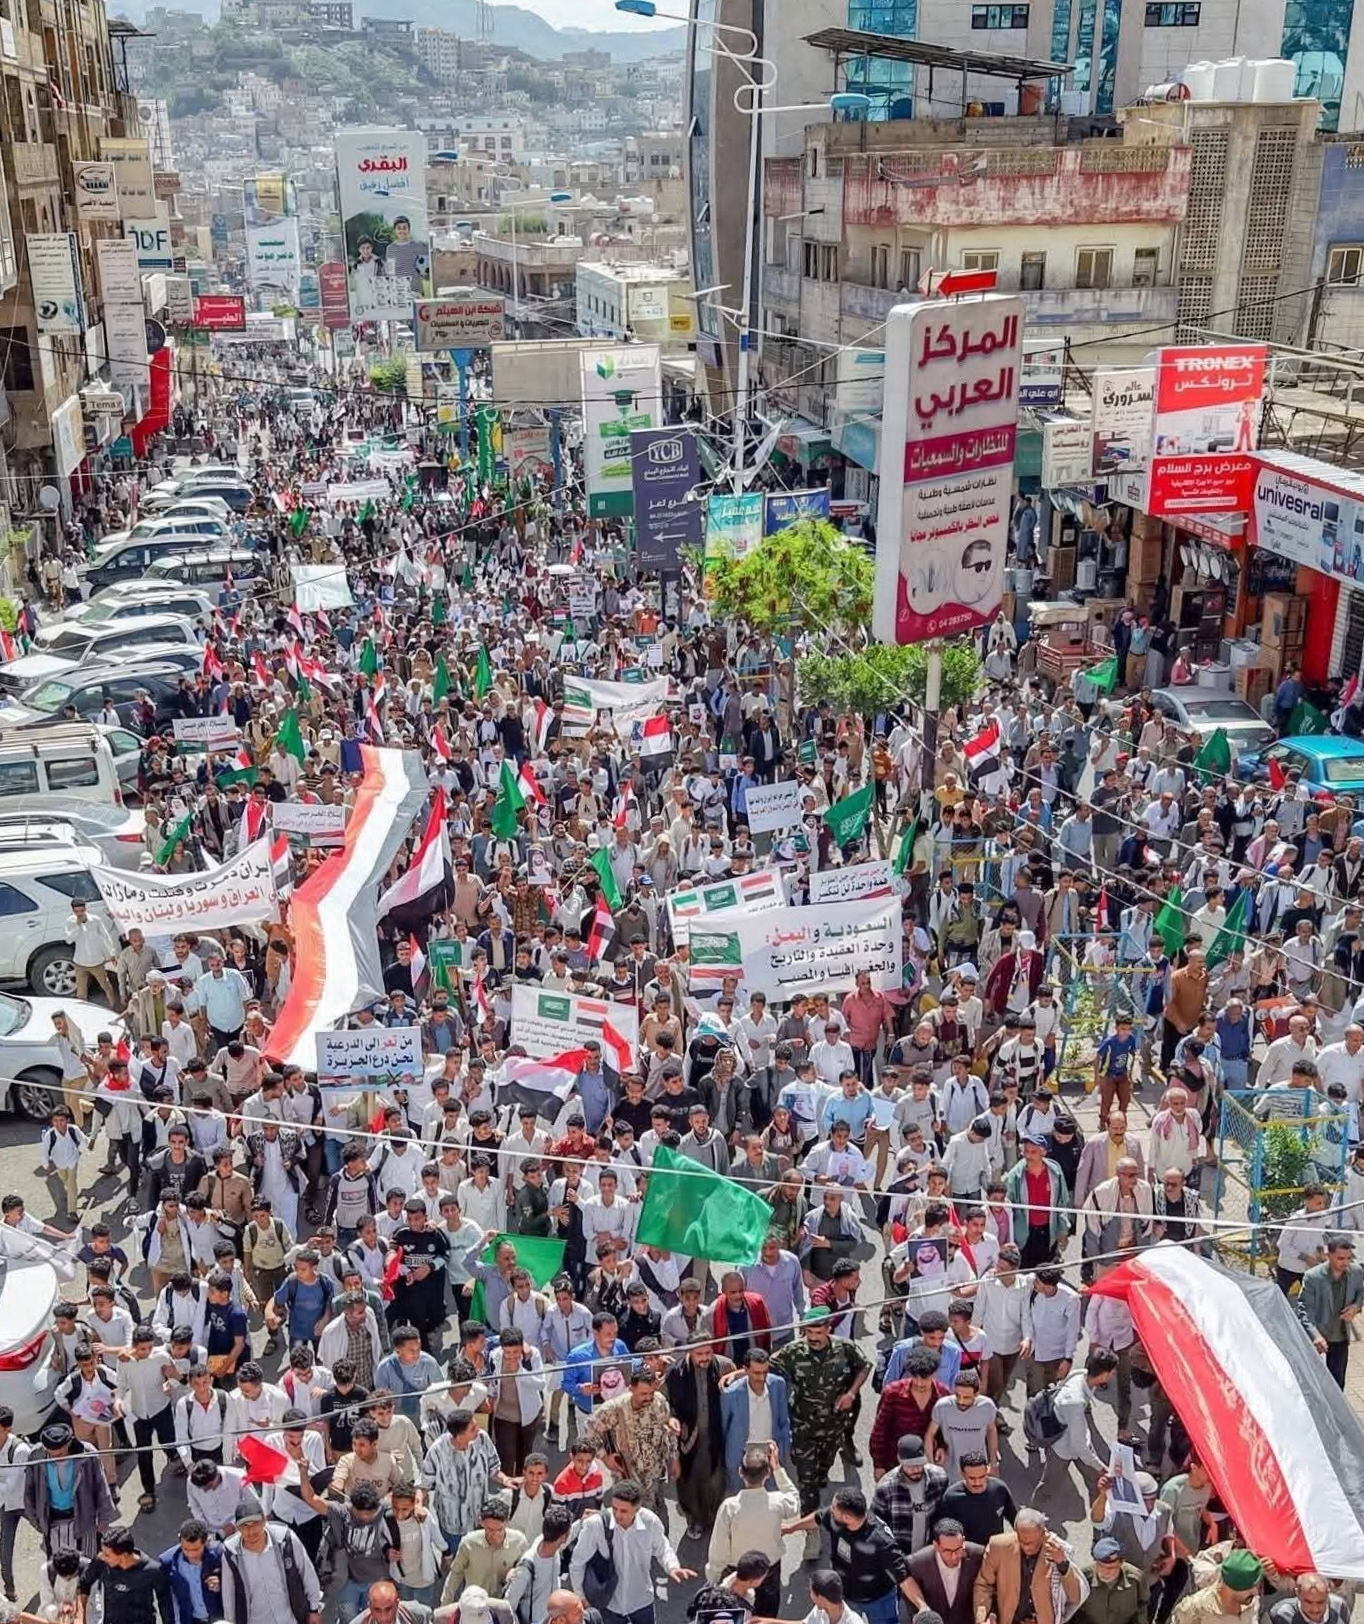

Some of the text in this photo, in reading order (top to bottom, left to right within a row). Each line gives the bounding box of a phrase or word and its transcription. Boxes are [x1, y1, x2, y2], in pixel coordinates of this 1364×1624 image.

[358, 155, 407, 172] البقري
[436, 302, 502, 318] شبكة ابن الهيثم
[918, 315, 1018, 368] المركز
[1174, 356, 1254, 372] TRONEX
[1125, 381, 1142, 393] عالم
[1174, 373, 1254, 392] ترونكس
[915, 367, 1013, 430] العربي
[1028, 388, 1047, 400] علي
[653, 443, 680, 460] YCB
[911, 432, 1009, 471] للنظارات والسمعيات
[1157, 462, 1251, 476] معرض برج السلام
[918, 477, 997, 500] نظارات شمسية وطبية
[648, 499, 666, 510] تعز
[1257, 484, 1324, 522] univesral
[964, 516, 982, 530] النظر
[983, 515, 1000, 528] فحص
[938, 617, 948, 629] 04
[195, 870, 239, 892] دمرت
[851, 880, 873, 892] واحدة
[228, 886, 263, 908] العراق
[818, 885, 840, 901] تنكسر
[841, 884, 850, 897] لن
[145, 902, 184, 923] ولبنان
[187, 896, 227, 913] وسوريا
[823, 916, 892, 941] السعودية
[770, 939, 894, 969] وحدة العقيدة والتاريخ
[774, 967, 825, 987] والمصير
[326, 1038, 363, 1052] الدرعية
[383, 1034, 398, 1051] تعز
[400, 1035, 412, 1049] من
[327, 1052, 414, 1069] نحن درع الجزيرة
